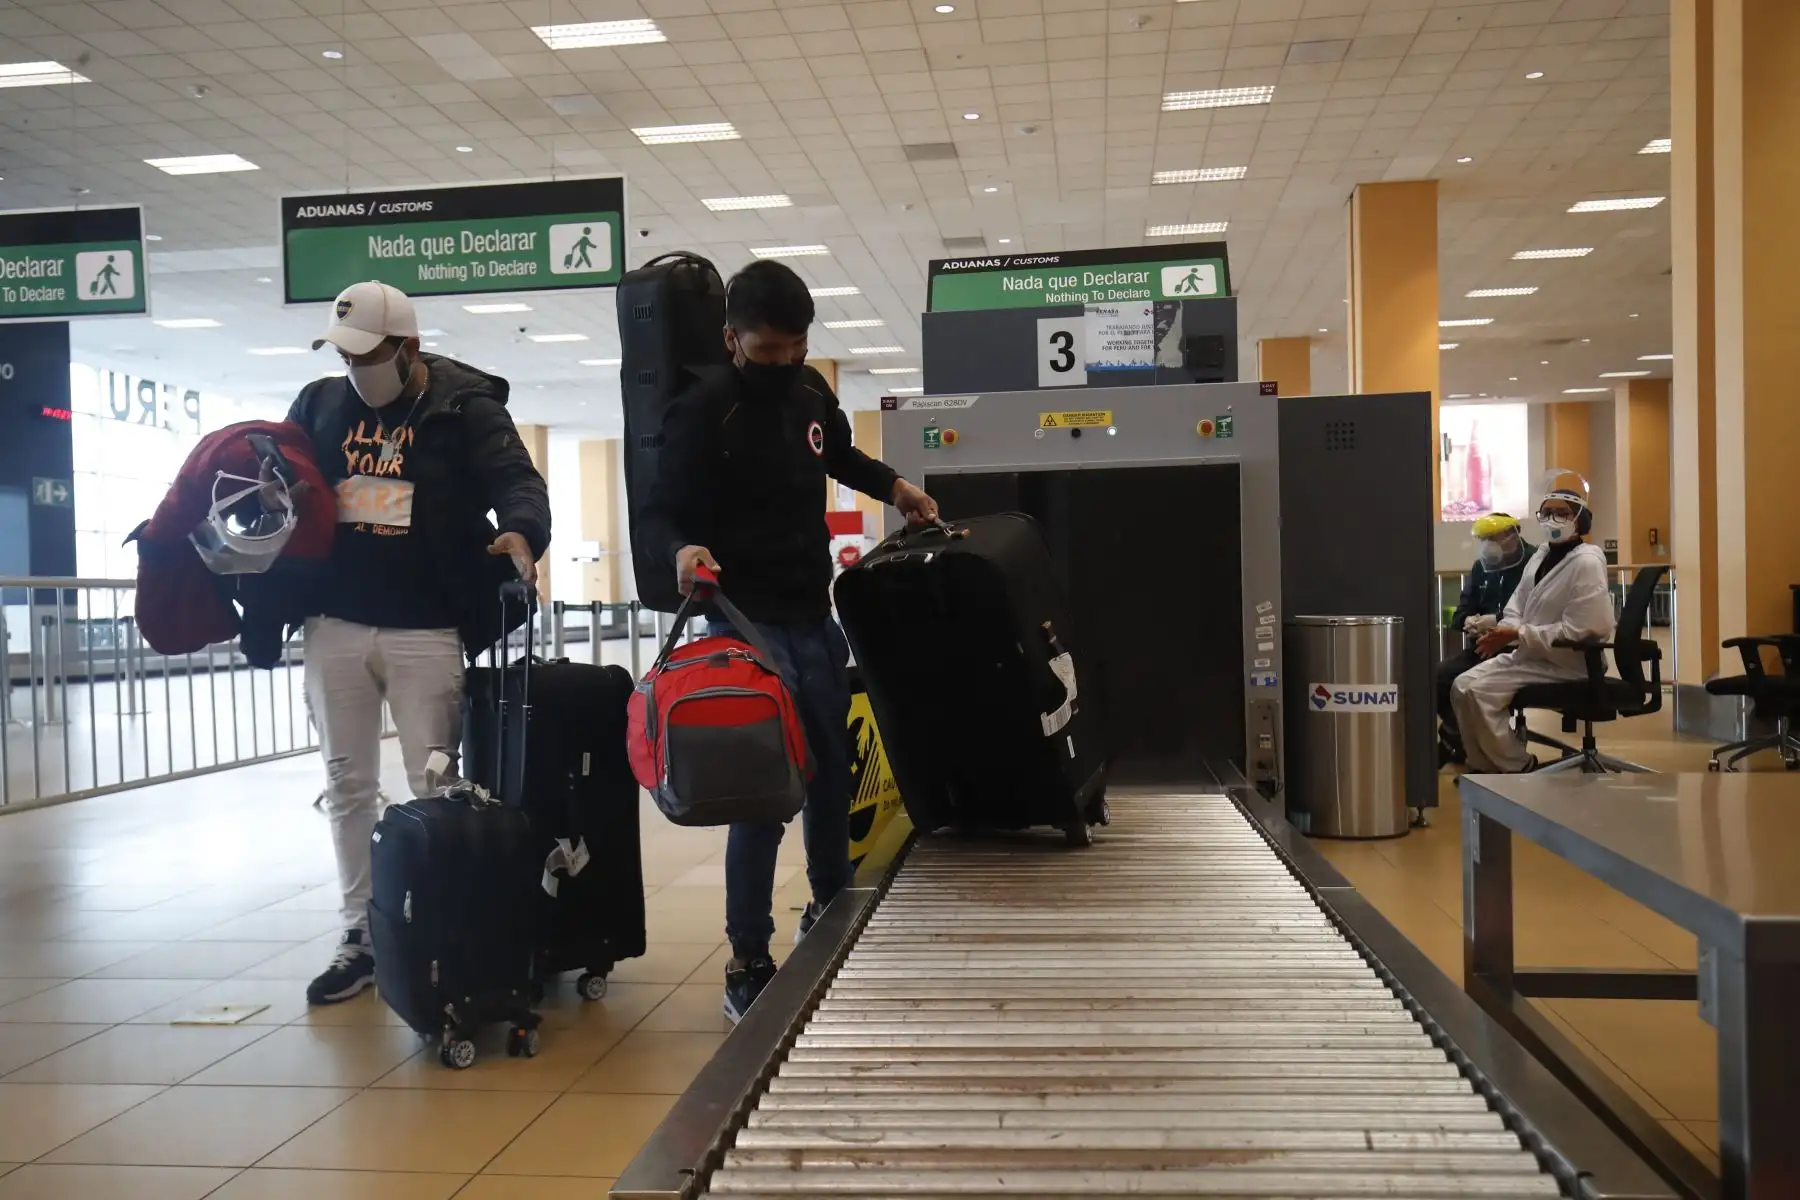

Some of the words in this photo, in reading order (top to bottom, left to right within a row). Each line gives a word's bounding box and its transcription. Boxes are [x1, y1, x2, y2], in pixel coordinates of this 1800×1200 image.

[296, 203, 365, 218] ADUANAS
[367, 201, 377, 216] /
[379, 201, 433, 213] CUSTOMS
[368, 234, 416, 258] Nada
[420, 236, 455, 260] que
[460, 229, 537, 253] Declarar
[418, 263, 468, 281] Nothing
[470, 261, 485, 277] To
[488, 260, 537, 277] Declare
[942, 259, 1001, 270] ADUANAS
[1003, 257, 1011, 267] /
[1013, 256, 1060, 265] CUSTOMS
[1003, 276, 1043, 291] Nada
[1048, 275, 1078, 290] que
[1083, 270, 1150, 287] Declarar
[2, 286, 17, 302] To
[20, 285, 65, 302] Declare
[1045, 292, 1089, 303] Nothing
[1091, 290, 1105, 301] To
[1107, 288, 1151, 300] Declare
[1049, 330, 1076, 373] 3
[345, 450, 404, 476] YOUR
[354, 522, 367, 532] AL
[1333, 691, 1397, 705] SUNAT
